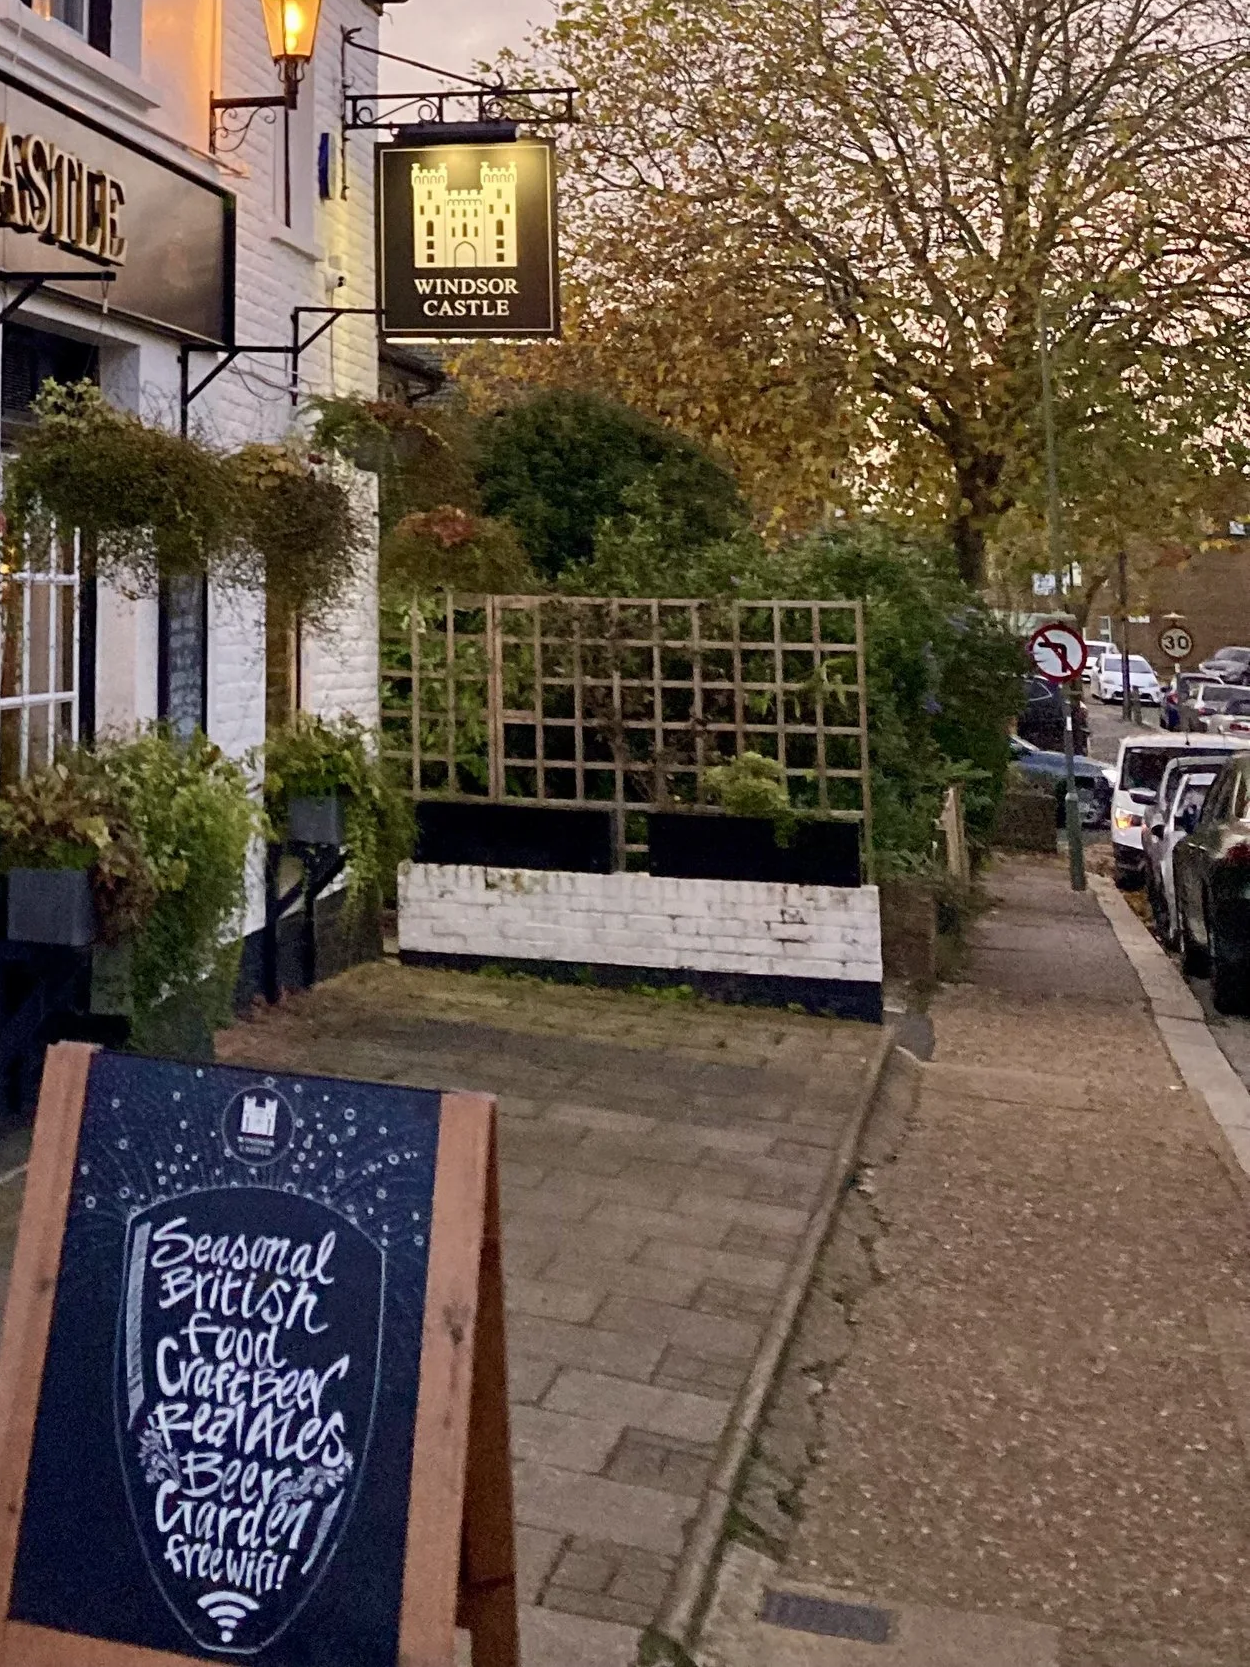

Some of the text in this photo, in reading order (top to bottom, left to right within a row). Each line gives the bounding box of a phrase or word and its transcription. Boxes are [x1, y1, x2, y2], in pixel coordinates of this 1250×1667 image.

[414, 277, 520, 295] WINDSOR
[422, 299, 510, 317] CASTLE
[1163, 635, 1190, 650] 30
[151, 1216, 337, 1285] Seasonal
[159, 1266, 329, 1334] British
[156, 1336, 350, 1417] Craft Beer
[153, 1401, 247, 1450] Real
[179, 1450, 293, 1505] Beer
[155, 1479, 313, 1549] Garden
